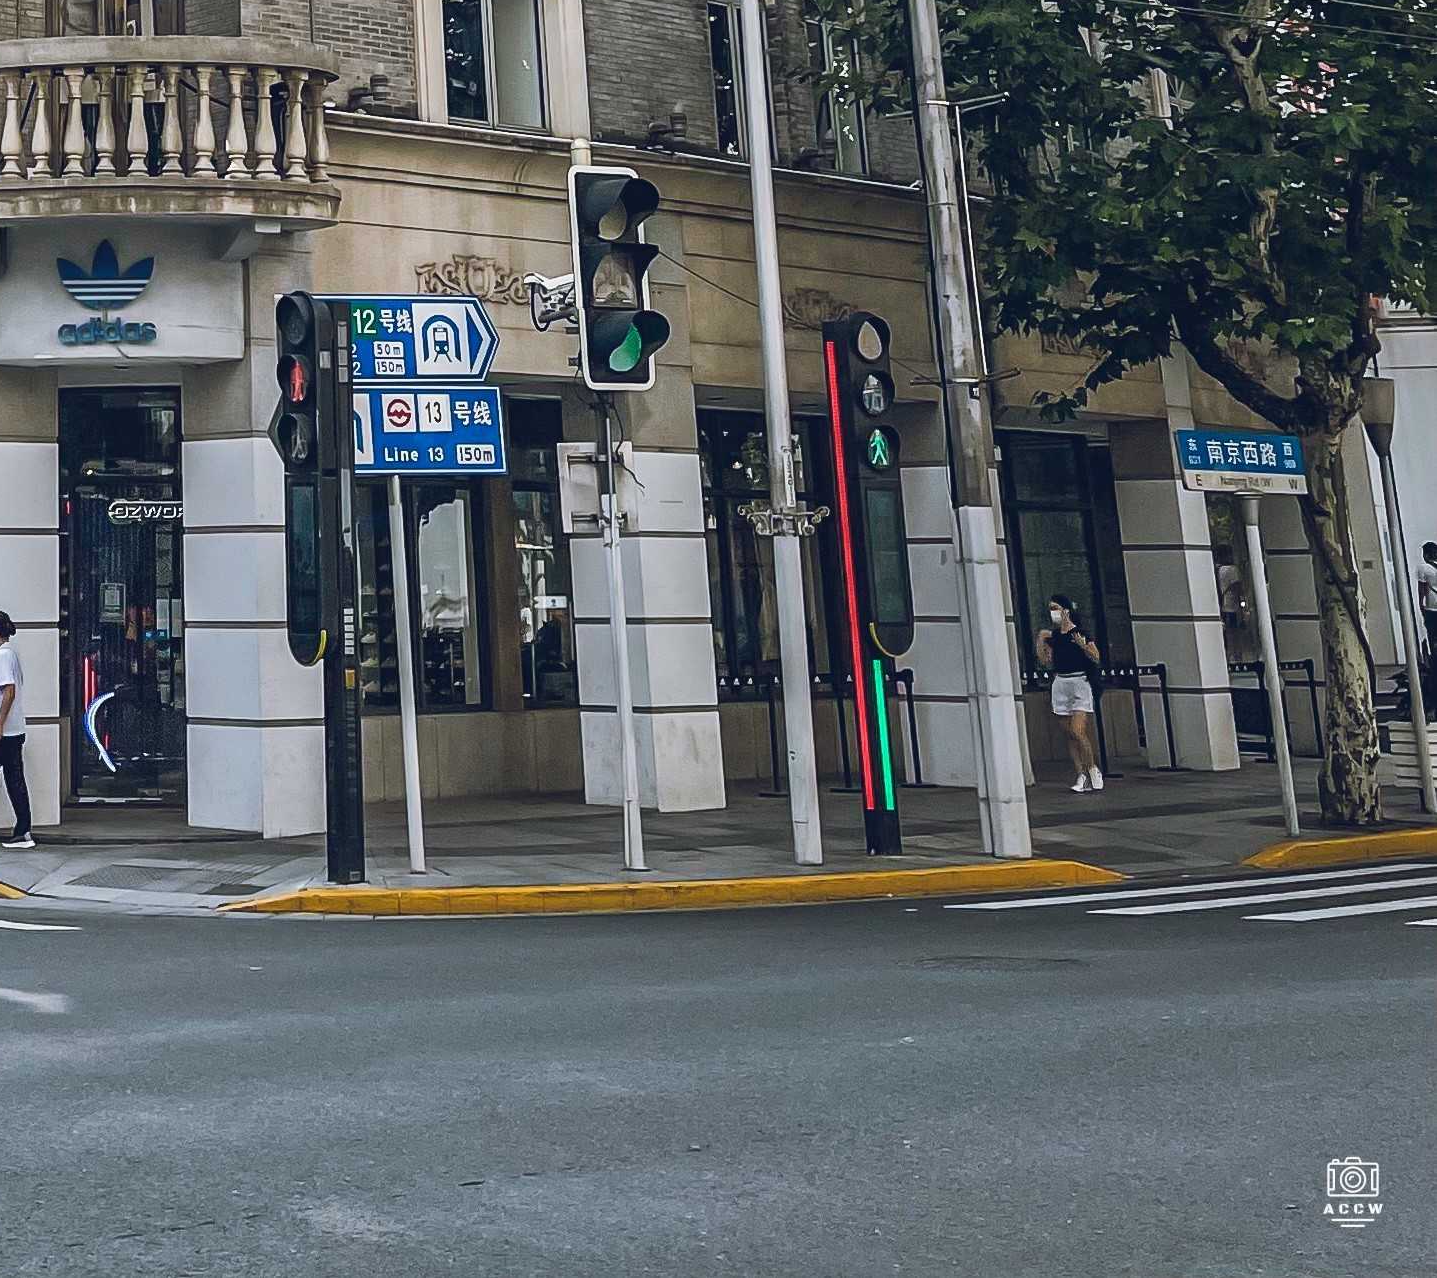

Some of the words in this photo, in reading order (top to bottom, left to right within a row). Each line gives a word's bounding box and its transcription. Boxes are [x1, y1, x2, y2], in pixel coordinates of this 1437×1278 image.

[58, 316, 157, 343] adidas
[376, 343, 401, 355] 50m
[376, 360, 403, 373] 150m
[384, 446, 419, 462] Line
[428, 447, 444, 462] 13
[458, 446, 493, 462] 150m
[1206, 439, 1277, 467] 南京西路
[1194, 474, 1203, 487] E
[1288, 479, 1298, 490] W
